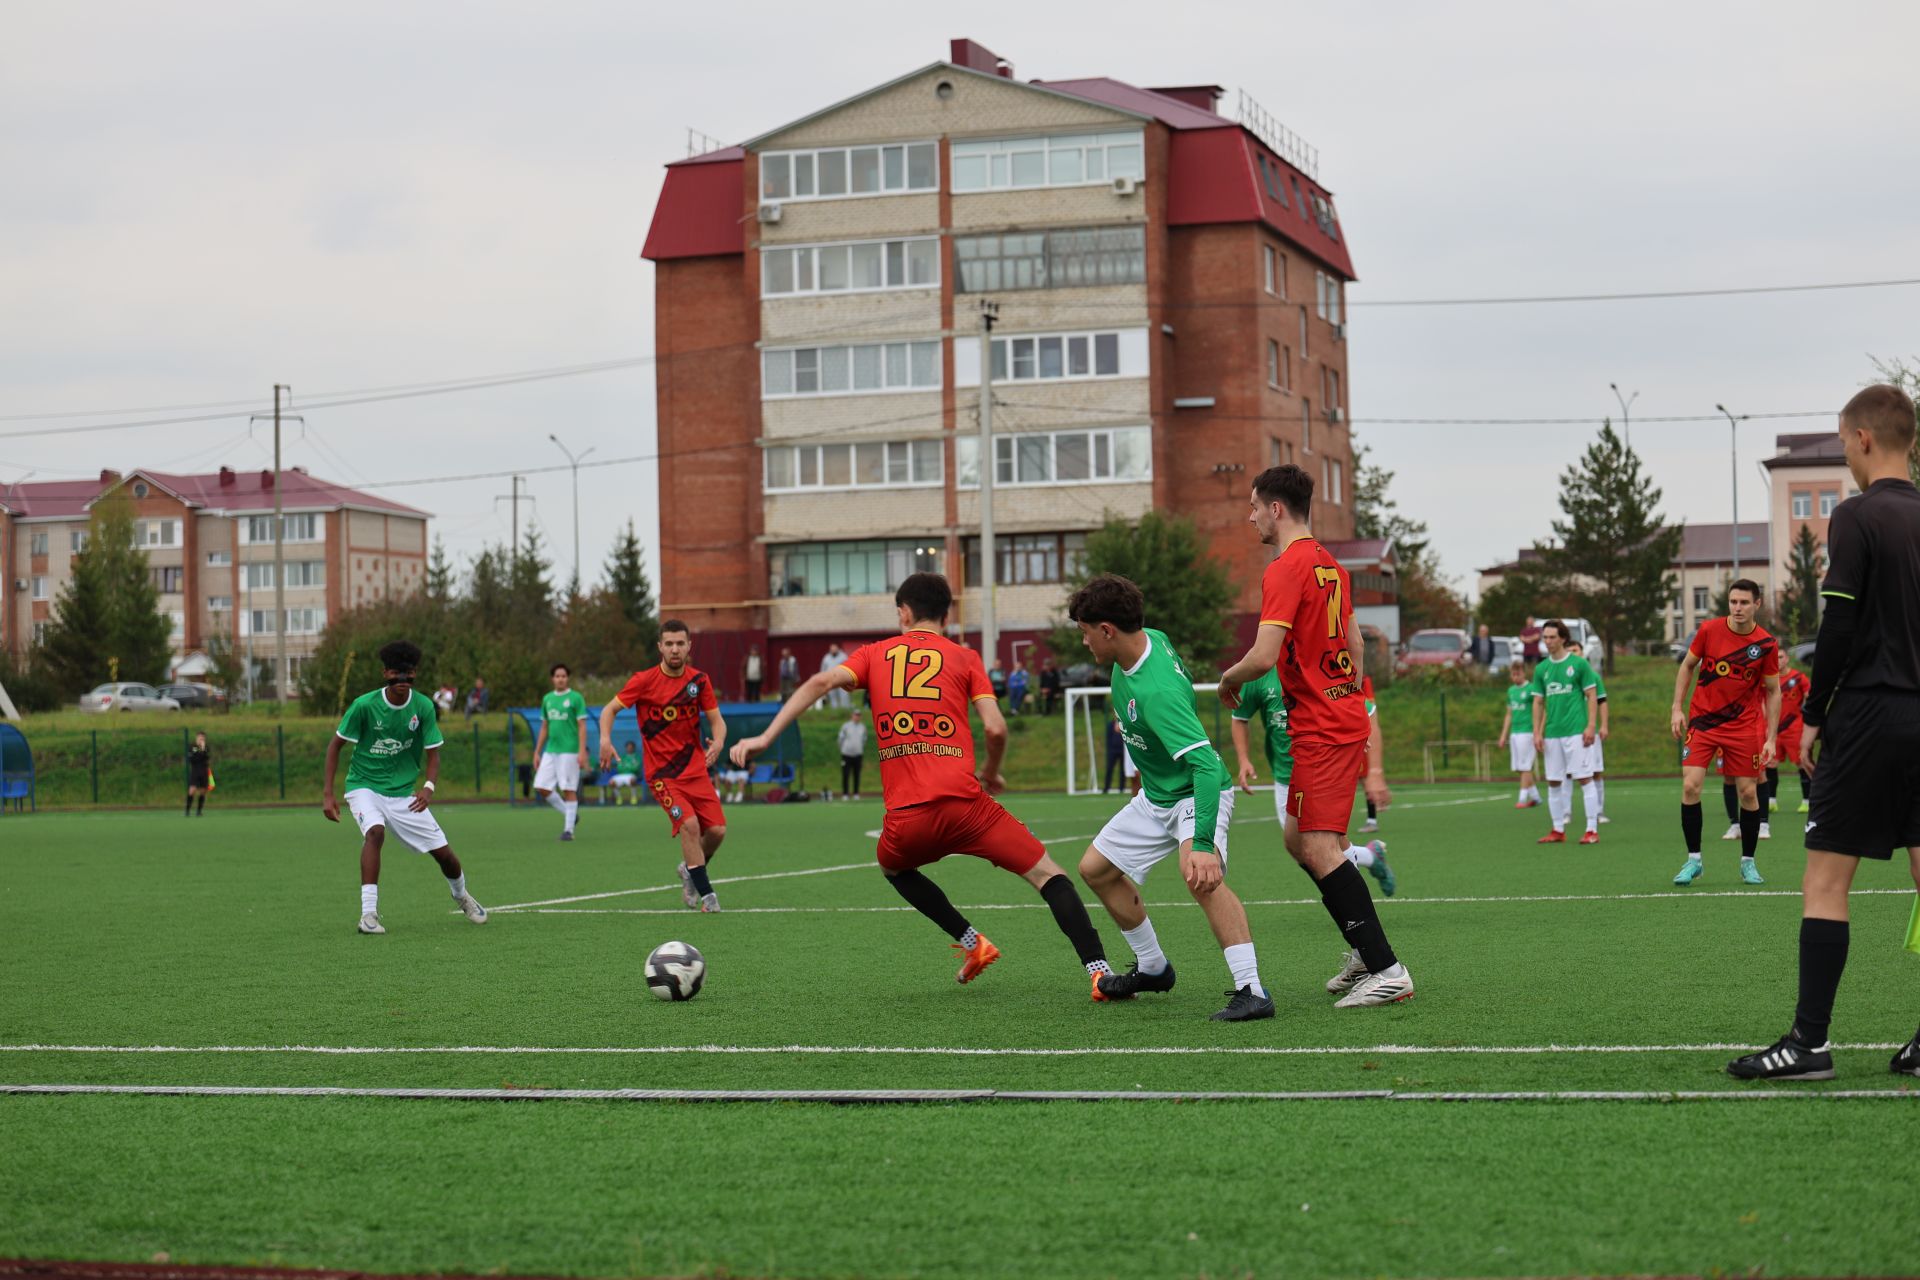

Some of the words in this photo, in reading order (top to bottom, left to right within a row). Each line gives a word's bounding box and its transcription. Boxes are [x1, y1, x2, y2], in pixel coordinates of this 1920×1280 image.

[1313, 565, 1345, 639] 7
[886, 644, 943, 700] 12
[877, 711, 956, 740] NODO
[879, 742, 933, 762] ТРОИТЕЛЬСТВО
[933, 744, 963, 758] ДОМОВ
[1752, 754, 1760, 770] 5
[1295, 791, 1304, 818] 7
